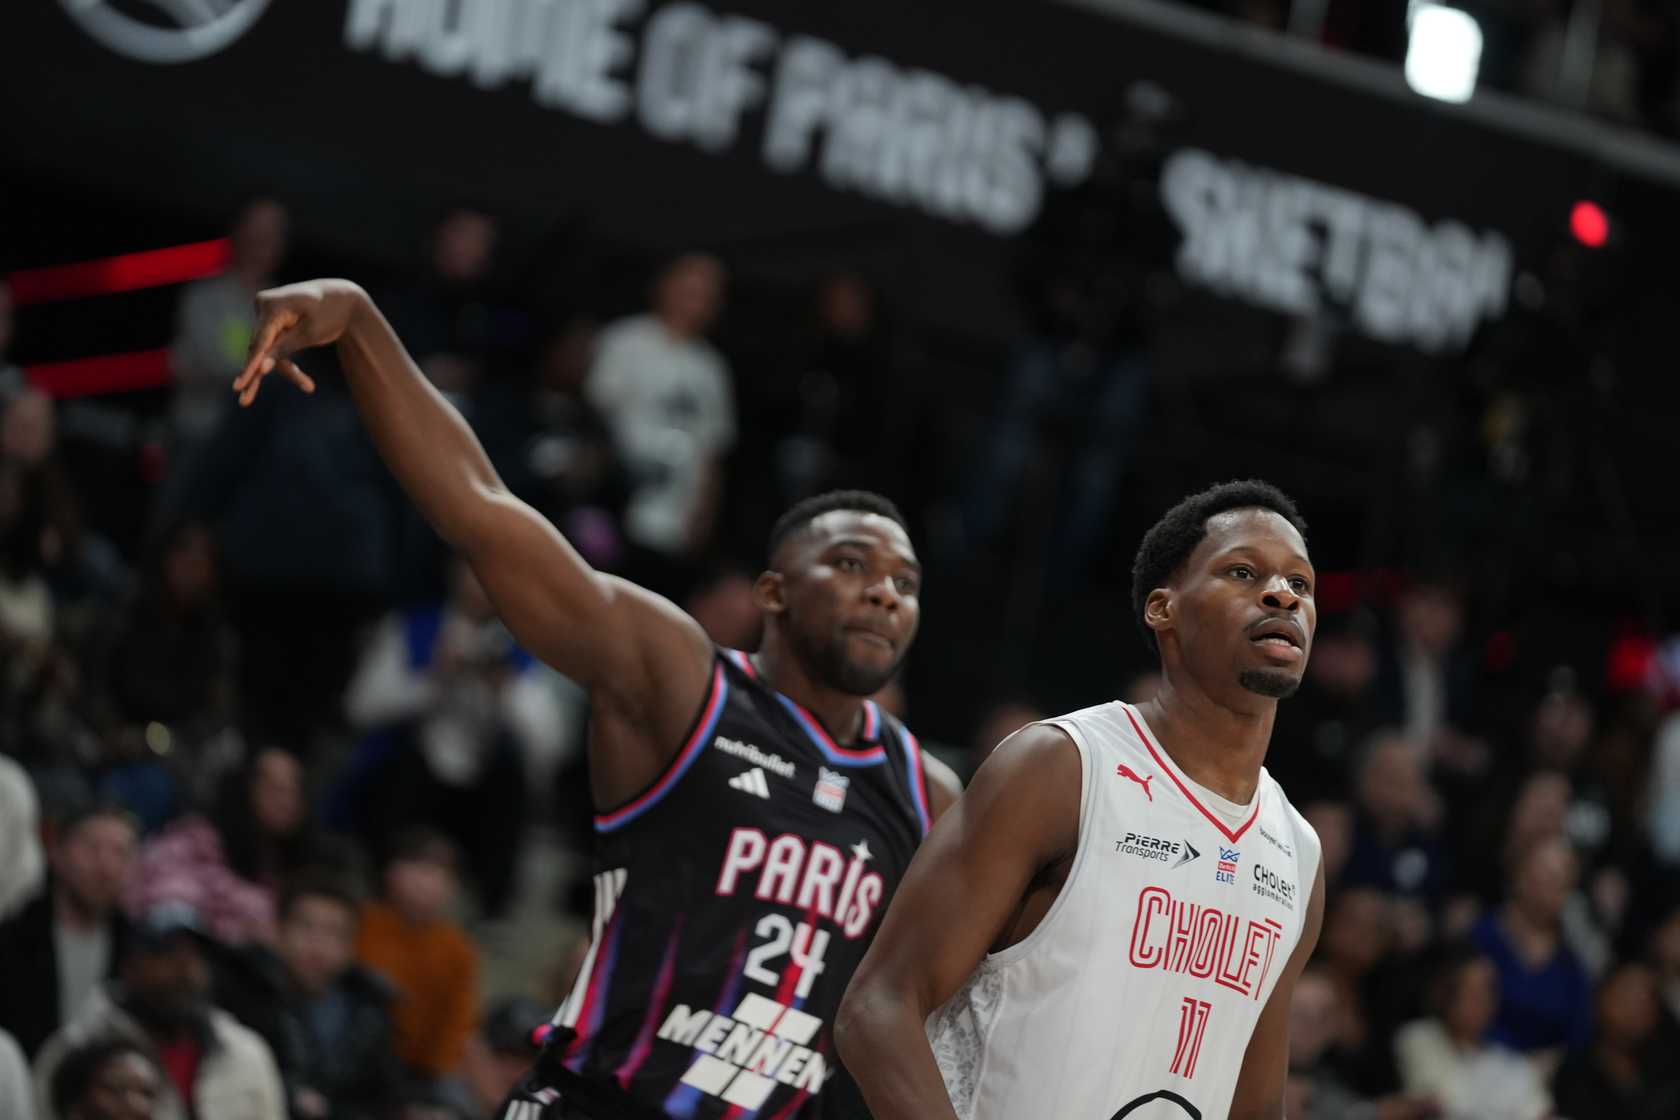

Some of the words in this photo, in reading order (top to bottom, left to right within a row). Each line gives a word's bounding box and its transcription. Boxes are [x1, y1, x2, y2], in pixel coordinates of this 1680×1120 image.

[1114, 840, 1169, 862] Transports
[743, 913, 831, 999] 24
[1129, 886, 1282, 1001] CHOLET
[655, 1003, 835, 1094] MENNEN
[1169, 997, 1212, 1080] 11
